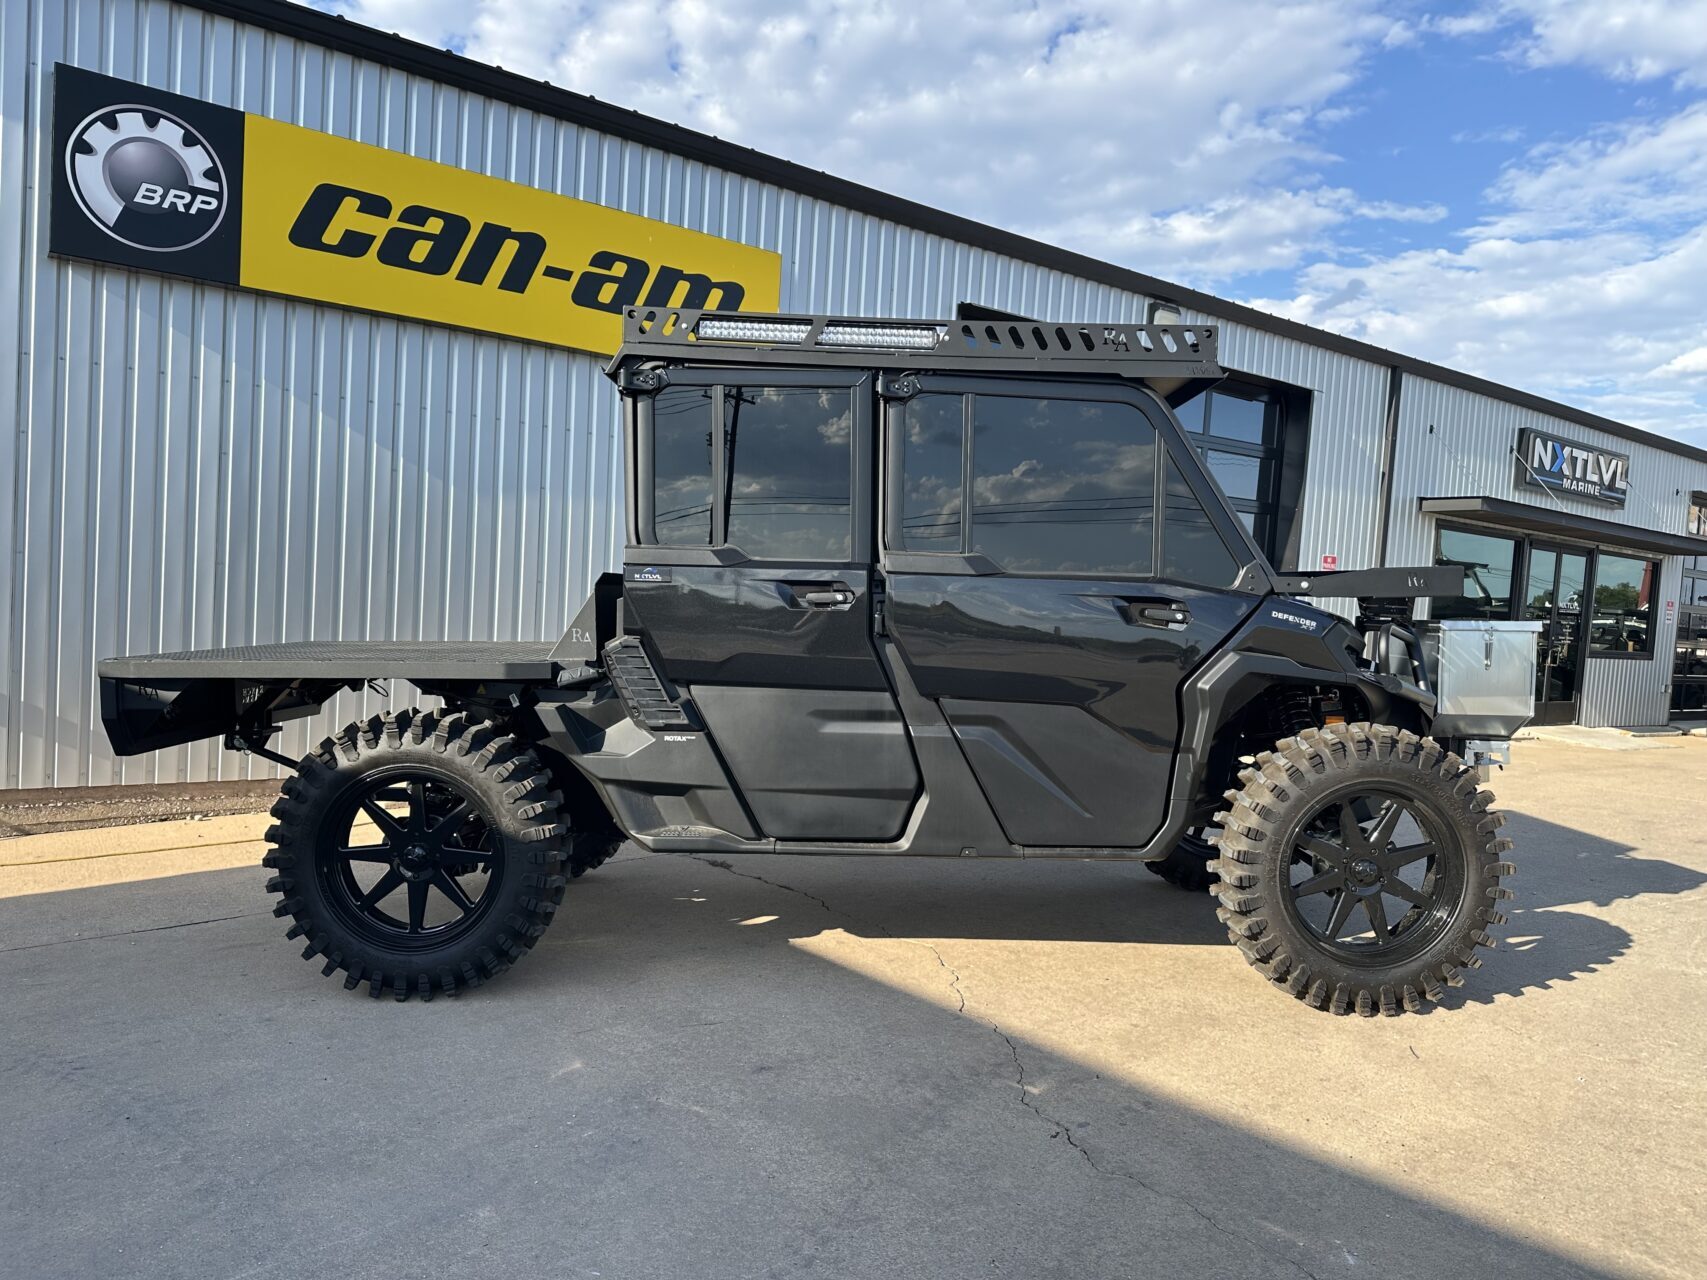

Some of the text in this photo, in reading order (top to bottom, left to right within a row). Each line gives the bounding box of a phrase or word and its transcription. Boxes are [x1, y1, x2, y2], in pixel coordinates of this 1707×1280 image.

[133, 182, 218, 214] BRP
[1533, 437, 1627, 489] NXTLVL
[1562, 478, 1601, 496] MARINE
[1271, 611, 1317, 627] DEFENDER
